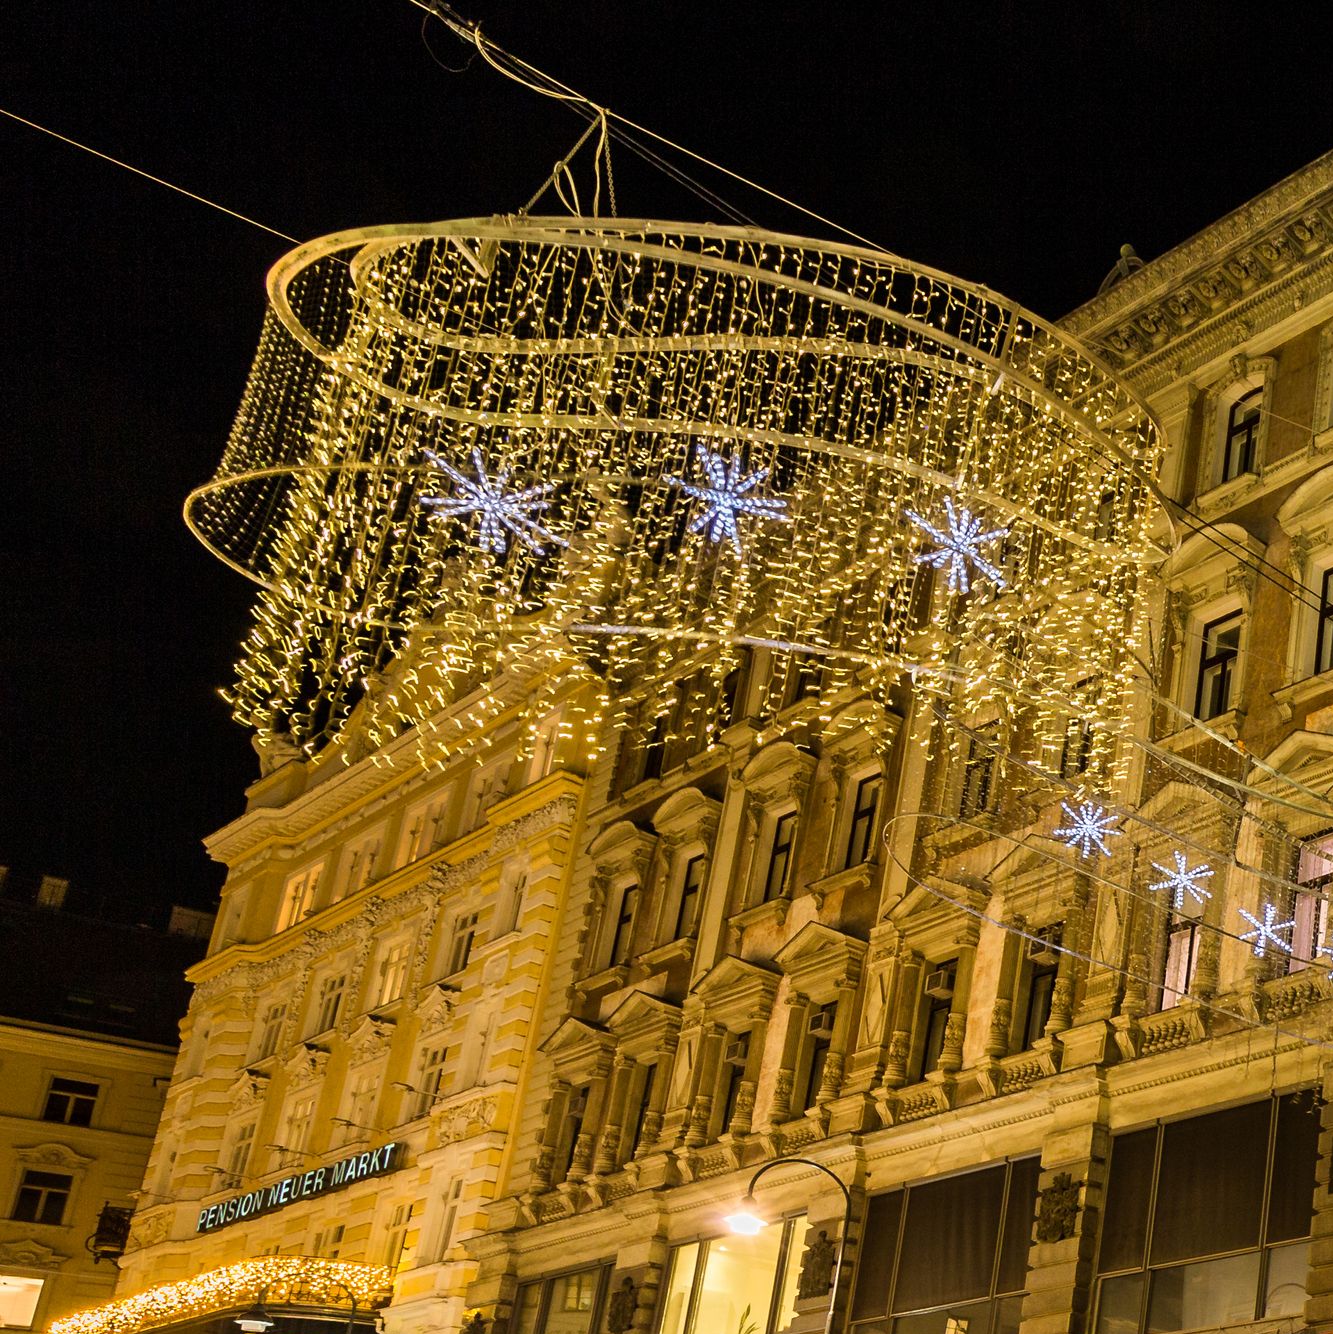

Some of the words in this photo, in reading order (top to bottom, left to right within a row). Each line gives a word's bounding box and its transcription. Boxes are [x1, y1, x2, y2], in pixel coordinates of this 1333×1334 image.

[196, 1189, 264, 1232] PENSION
[267, 1168, 325, 1207] NEUER
[331, 1143, 395, 1187] MARKT
